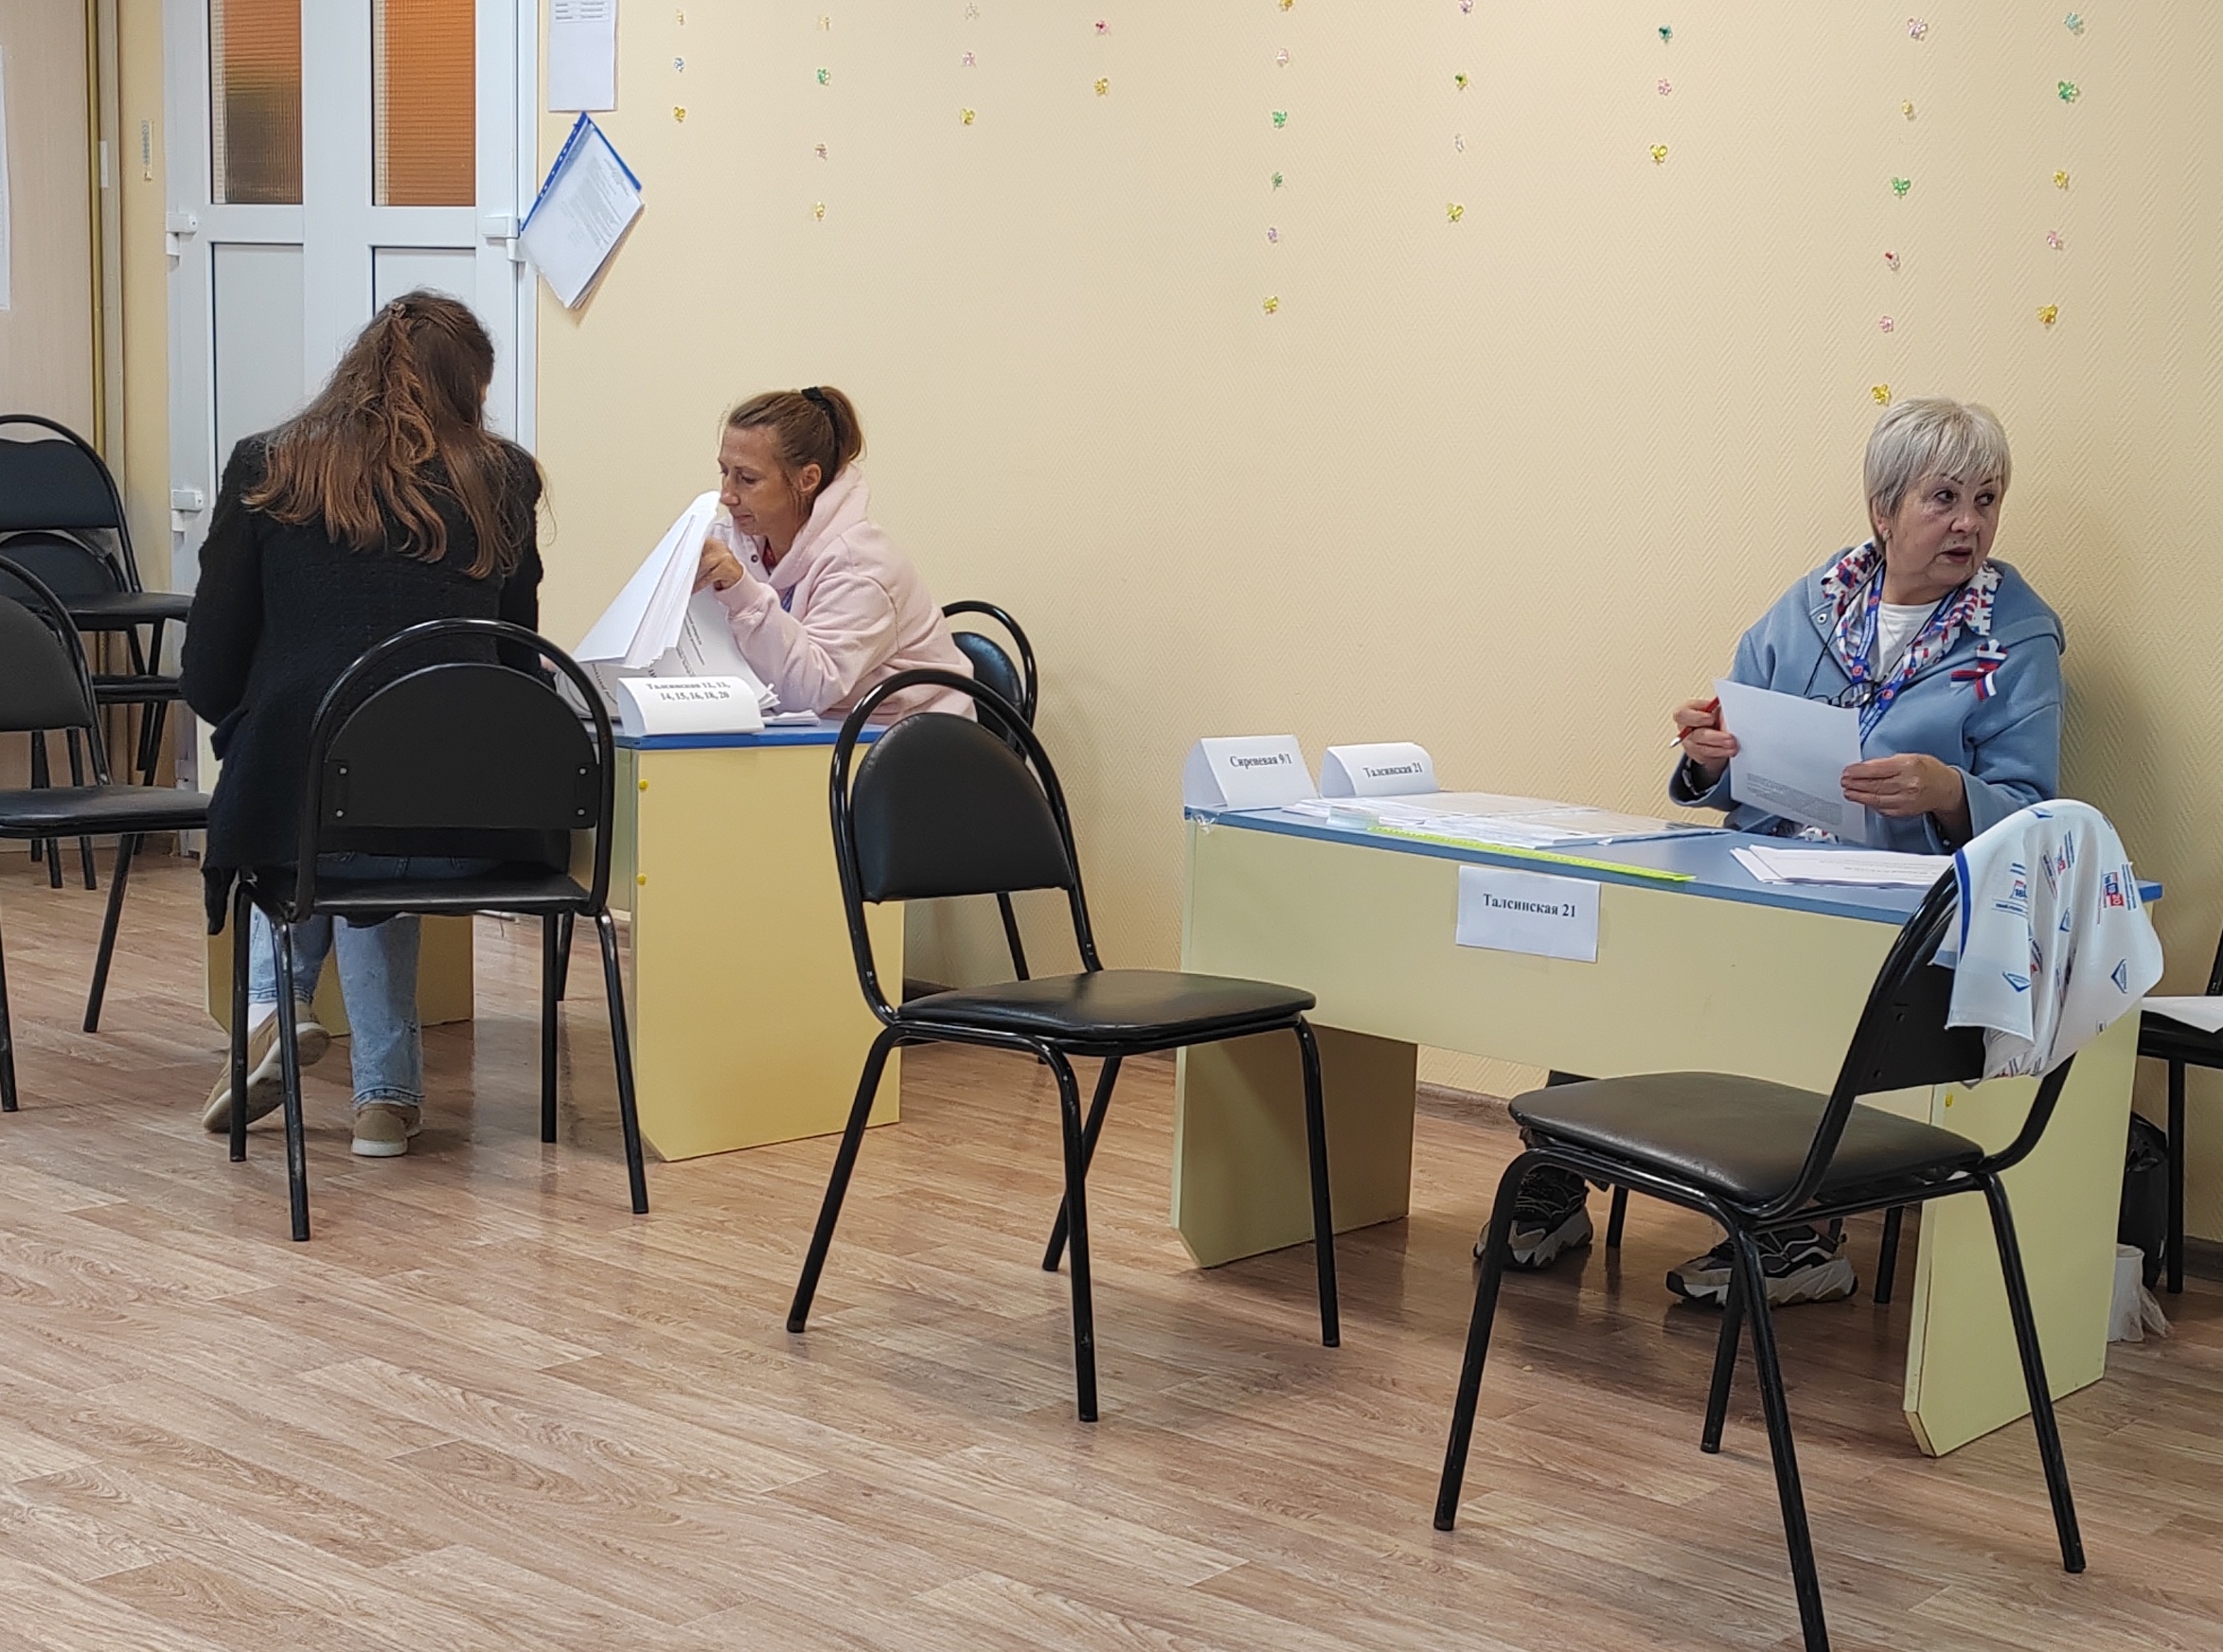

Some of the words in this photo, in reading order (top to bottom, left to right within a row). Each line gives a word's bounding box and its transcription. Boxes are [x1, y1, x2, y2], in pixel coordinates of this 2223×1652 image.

[1229, 755, 1278, 770] Сиреневая
[1361, 766, 1413, 778] Талсинская
[1412, 761, 1424, 773] 21
[1483, 893, 1558, 915] Талсинская
[1561, 903, 1576, 917] 21
